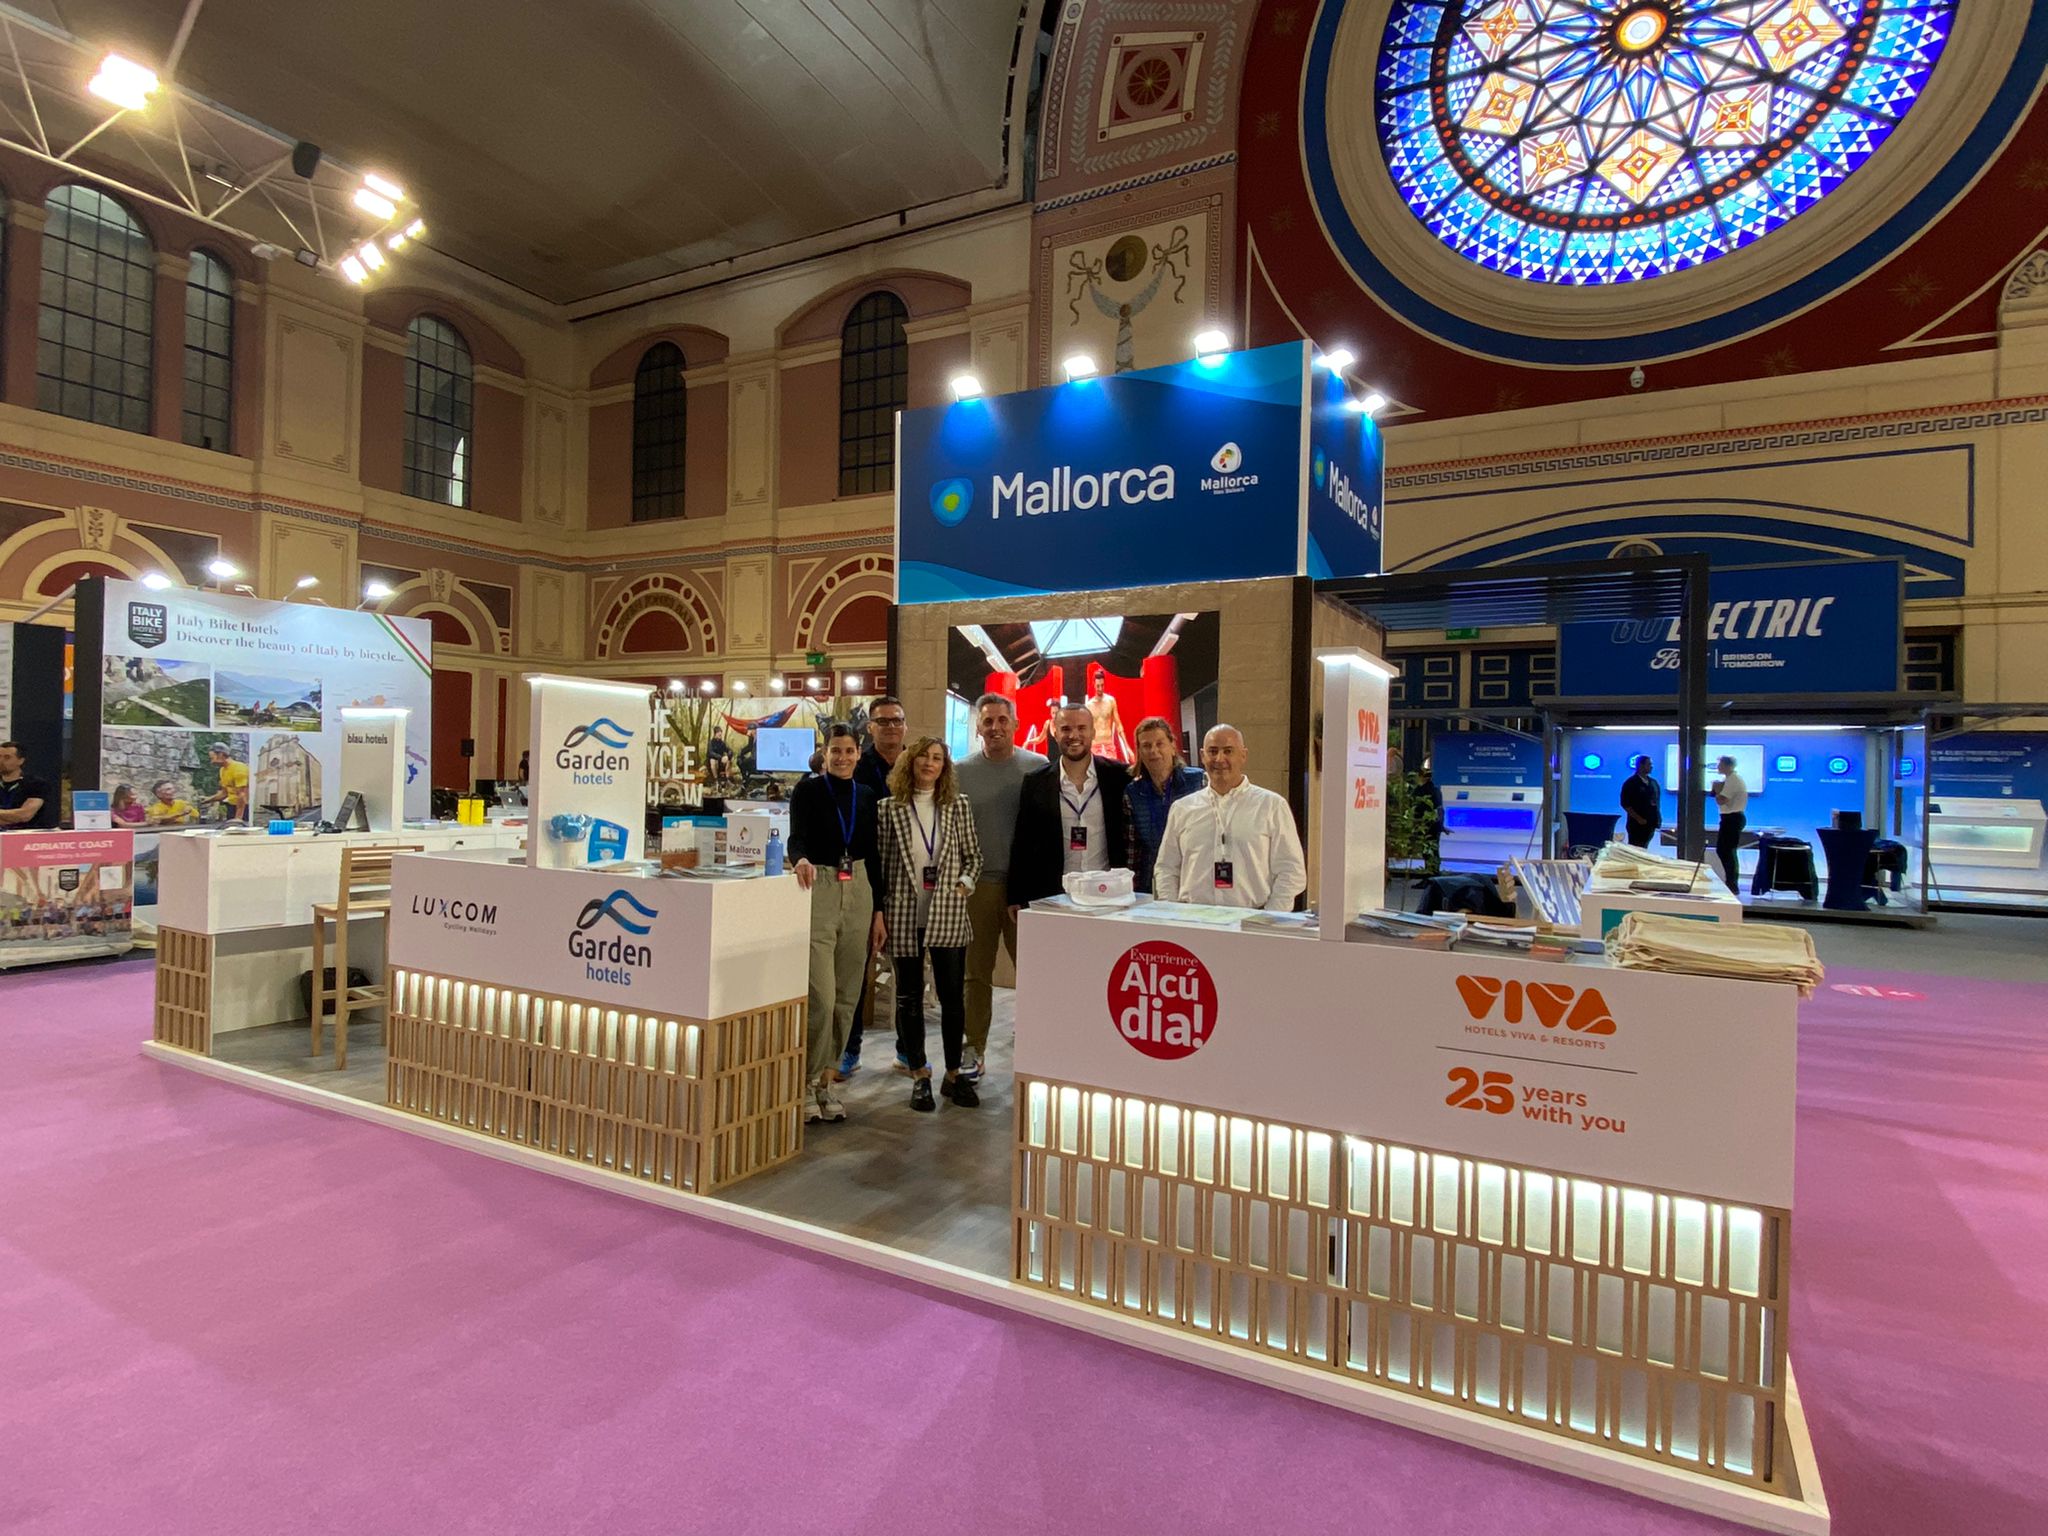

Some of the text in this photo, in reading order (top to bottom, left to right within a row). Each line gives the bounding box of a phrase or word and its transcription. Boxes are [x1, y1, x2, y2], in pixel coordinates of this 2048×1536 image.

[992, 464, 1176, 520] Mallorca
[1201, 474, 1259, 491] Mallorca
[1329, 460, 1368, 531] Mallorca
[133, 605, 162, 618] ITALY
[133, 615, 163, 628] BIKE
[177, 614, 279, 636] Italy Bike Hotels
[1666, 597, 1835, 642] ECTRIC
[177, 630, 233, 646] Discover
[235, 637, 255, 649] the
[258, 638, 297, 655] beauty
[301, 643, 313, 654] of
[316, 644, 339, 658] Italy
[343, 646, 355, 660] by
[1722, 652, 1773, 661] BRING ON
[1721, 660, 1786, 669] TOMORROW
[649, 708, 671, 743] HE
[556, 748, 630, 771] Garden
[647, 744, 696, 781] YCLE
[573, 771, 614, 785] hotels
[647, 780, 704, 808] HOW
[1354, 777, 1366, 809] 25
[23, 840, 115, 851] ADRIATIC COAST
[729, 845, 761, 855] Mallorca
[412, 895, 498, 925] LUXCOM
[444, 922, 467, 933] Cycling
[568, 930, 652, 968] Garden
[1130, 948, 1199, 967] Experience
[586, 961, 631, 986] hotels
[1120, 961, 1200, 1002] Alcú
[1455, 975, 1617, 1036] VIVA
[1120, 995, 1204, 1049] dia!
[1464, 1025, 1606, 1050] HOTELS VIVA & RESORTS
[1445, 1066, 1588, 1115] 25 years
[1522, 1105, 1626, 1133] with you
